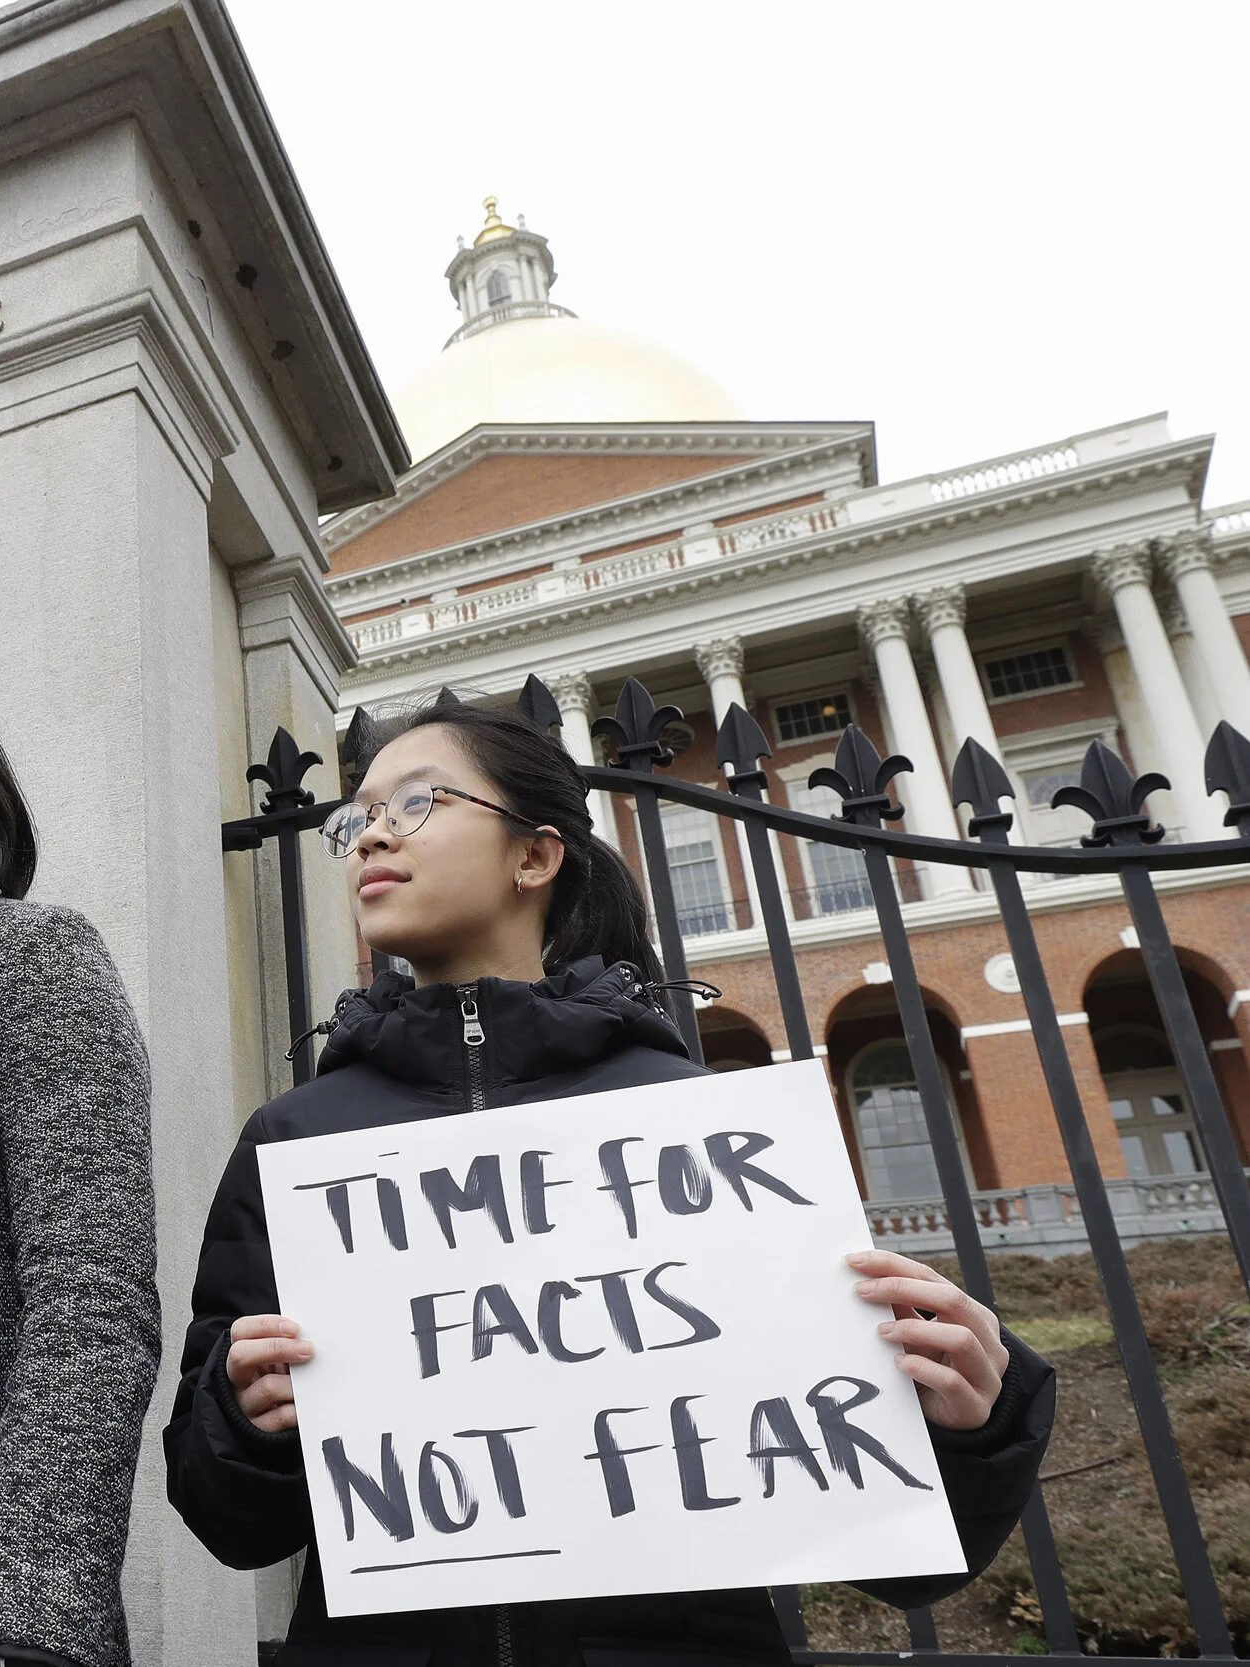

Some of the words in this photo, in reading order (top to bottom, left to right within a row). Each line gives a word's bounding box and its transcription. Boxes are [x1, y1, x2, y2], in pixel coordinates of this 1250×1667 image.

[597, 1132, 818, 1239] FOR
[410, 1262, 721, 1380] FACTS
[322, 1427, 537, 1542] NOT
[584, 1376, 934, 1518] FEAR
